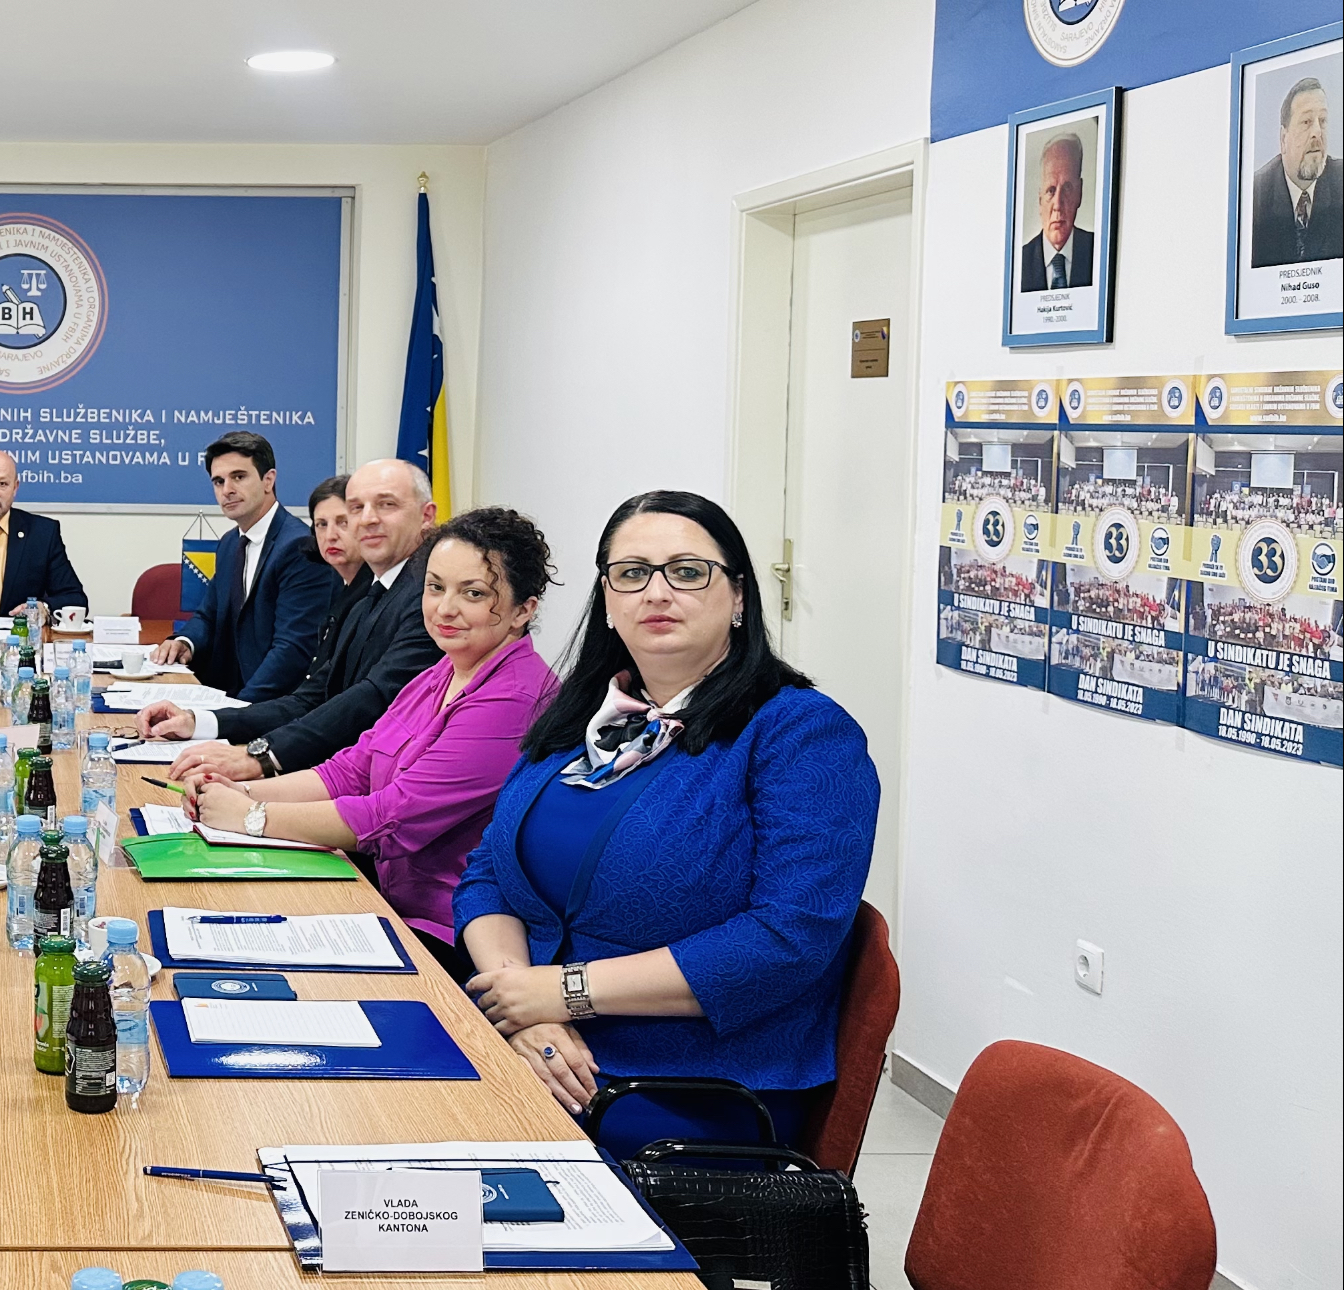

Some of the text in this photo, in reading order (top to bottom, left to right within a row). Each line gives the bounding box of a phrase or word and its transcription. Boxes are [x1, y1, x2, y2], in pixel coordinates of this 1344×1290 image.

[38, 229, 92, 285] NAMJEŠTENIKA
[13, 238, 49, 253] JAVNIM
[49, 250, 84, 310] USTANOVAMA
[1281, 281, 1320, 292] Nihad Guso
[1, 306, 34, 321] B H
[74, 295, 96, 350] ORGANIMA
[37, 346, 77, 376] DRŽAVNE
[39, 404, 155, 423] SLUŽBENIKA
[161, 409, 167, 423] I
[173, 406, 316, 425] NAMJEŠTENIKA
[89, 425, 165, 446] SLUŽBE,
[48, 450, 170, 465] USTANOVAMA
[178, 451, 190, 466] U
[984, 513, 1005, 542] 33
[1105, 526, 1128, 557] 33
[1253, 541, 1283, 577] 33
[1079, 616, 1123, 638] SINDIKATU
[1124, 624, 1133, 640] JE
[1134, 626, 1165, 647] SNAGA
[1216, 642, 1276, 668] SINDIKATU
[1278, 652, 1290, 671] JE
[1292, 655, 1331, 679] SNAGA
[1078, 674, 1143, 703] DAN SINDIKATA
[1110, 698, 1143, 714] 18.05.2023
[1219, 707, 1303, 743] DAN SINDIKATA
[1218, 726, 1256, 744] 18.05.1990
[1261, 736, 1303, 755] 18.05.2023
[383, 1199, 419, 1208] VLADA
[378, 1223, 429, 1233] KANTONA
